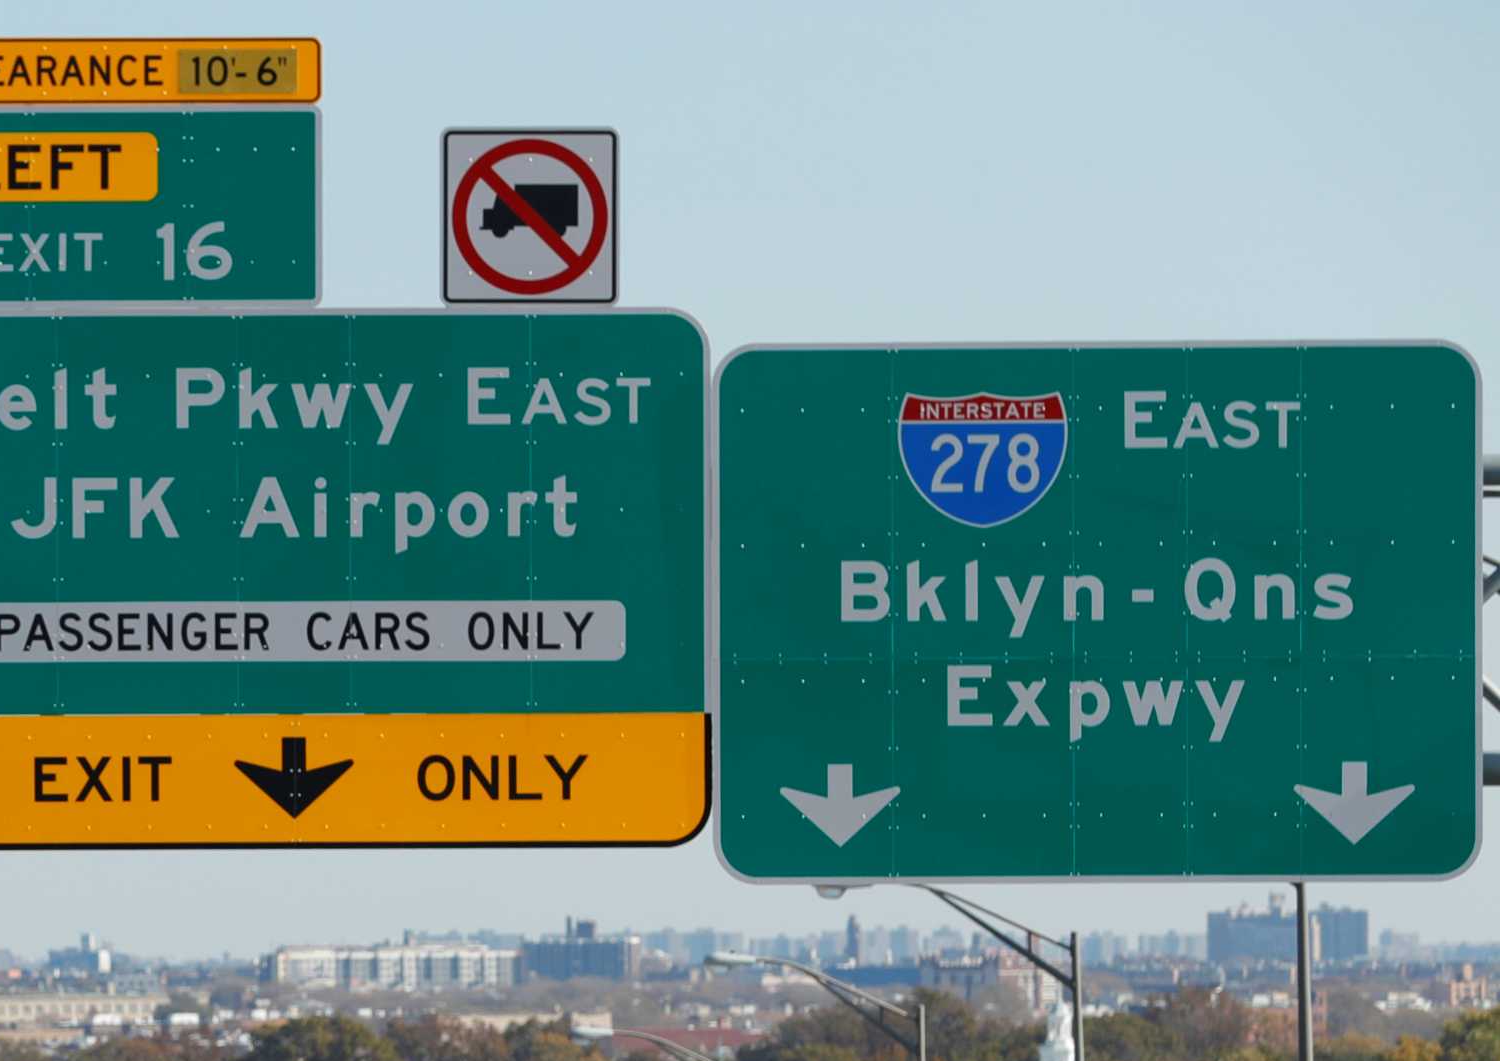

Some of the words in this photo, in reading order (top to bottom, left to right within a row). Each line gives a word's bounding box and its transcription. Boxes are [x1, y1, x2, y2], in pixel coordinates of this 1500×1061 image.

[157, 222, 232, 280] 16
[176, 368, 413, 444] Pkwy
[468, 368, 651, 425] EAST
[920, 402, 1047, 420] INTERSTATE
[1124, 391, 1300, 448] EAST
[930, 434, 1041, 494] 278
[12, 477, 179, 538] JFK
[240, 475, 577, 553] Airport
[307, 612, 429, 650] CARS
[468, 612, 593, 650] ONLY
[948, 666, 1244, 742] Expwy
[35, 757, 171, 801] EXIT
[418, 755, 587, 801] ONLY
